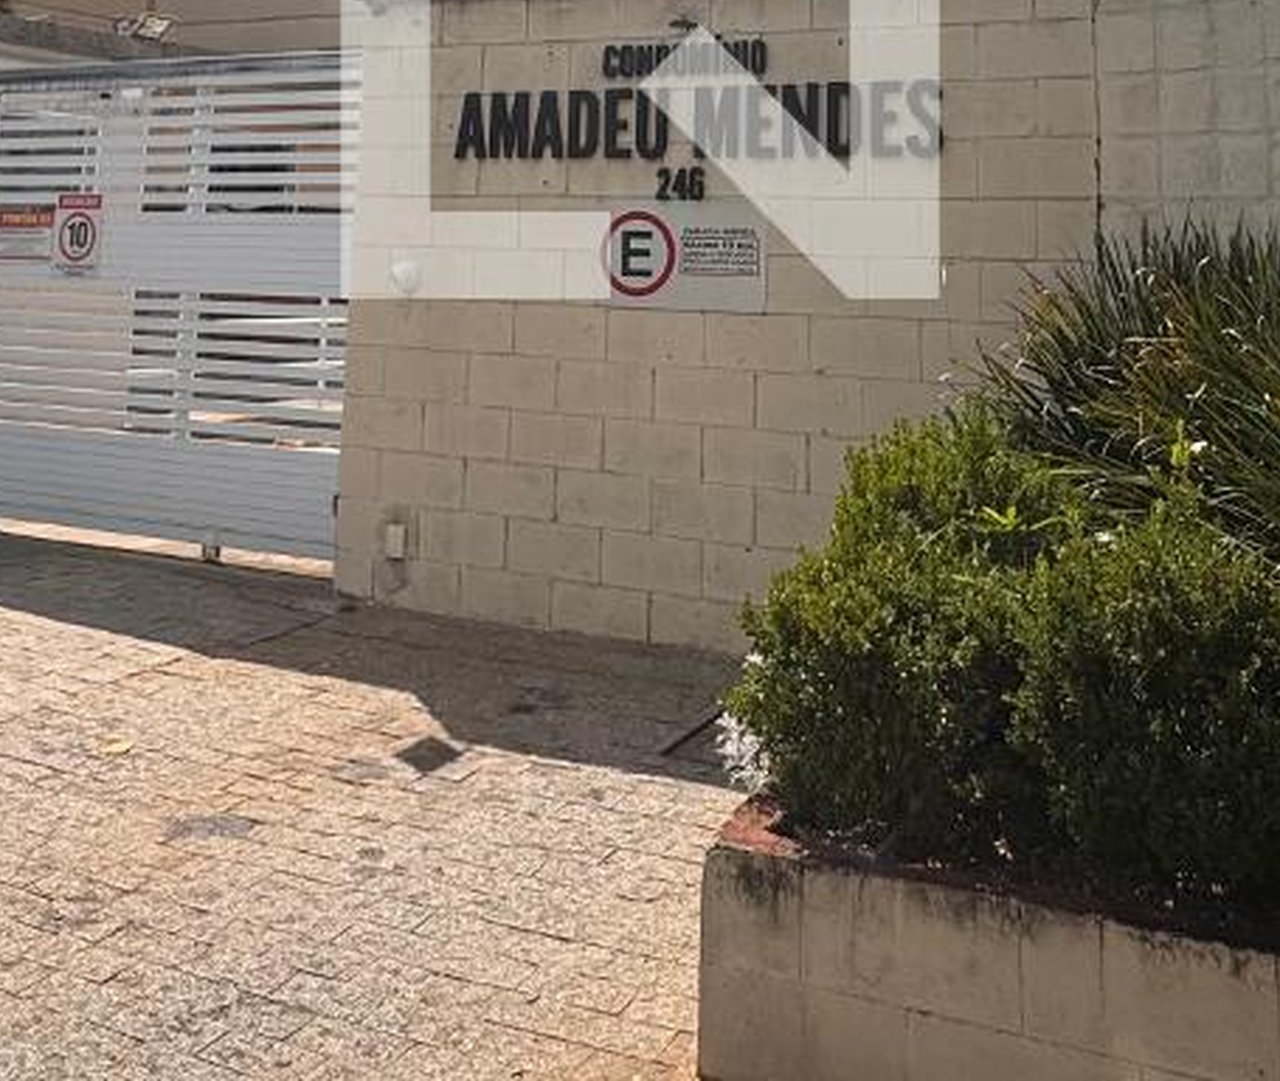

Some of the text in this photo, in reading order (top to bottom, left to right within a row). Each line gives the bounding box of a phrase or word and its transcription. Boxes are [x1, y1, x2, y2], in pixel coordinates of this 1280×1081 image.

[454, 78, 944, 160] AMADEU MENDES
[655, 167, 705, 202] 246
[67, 221, 89, 248] 10
[620, 230, 654, 277] E
